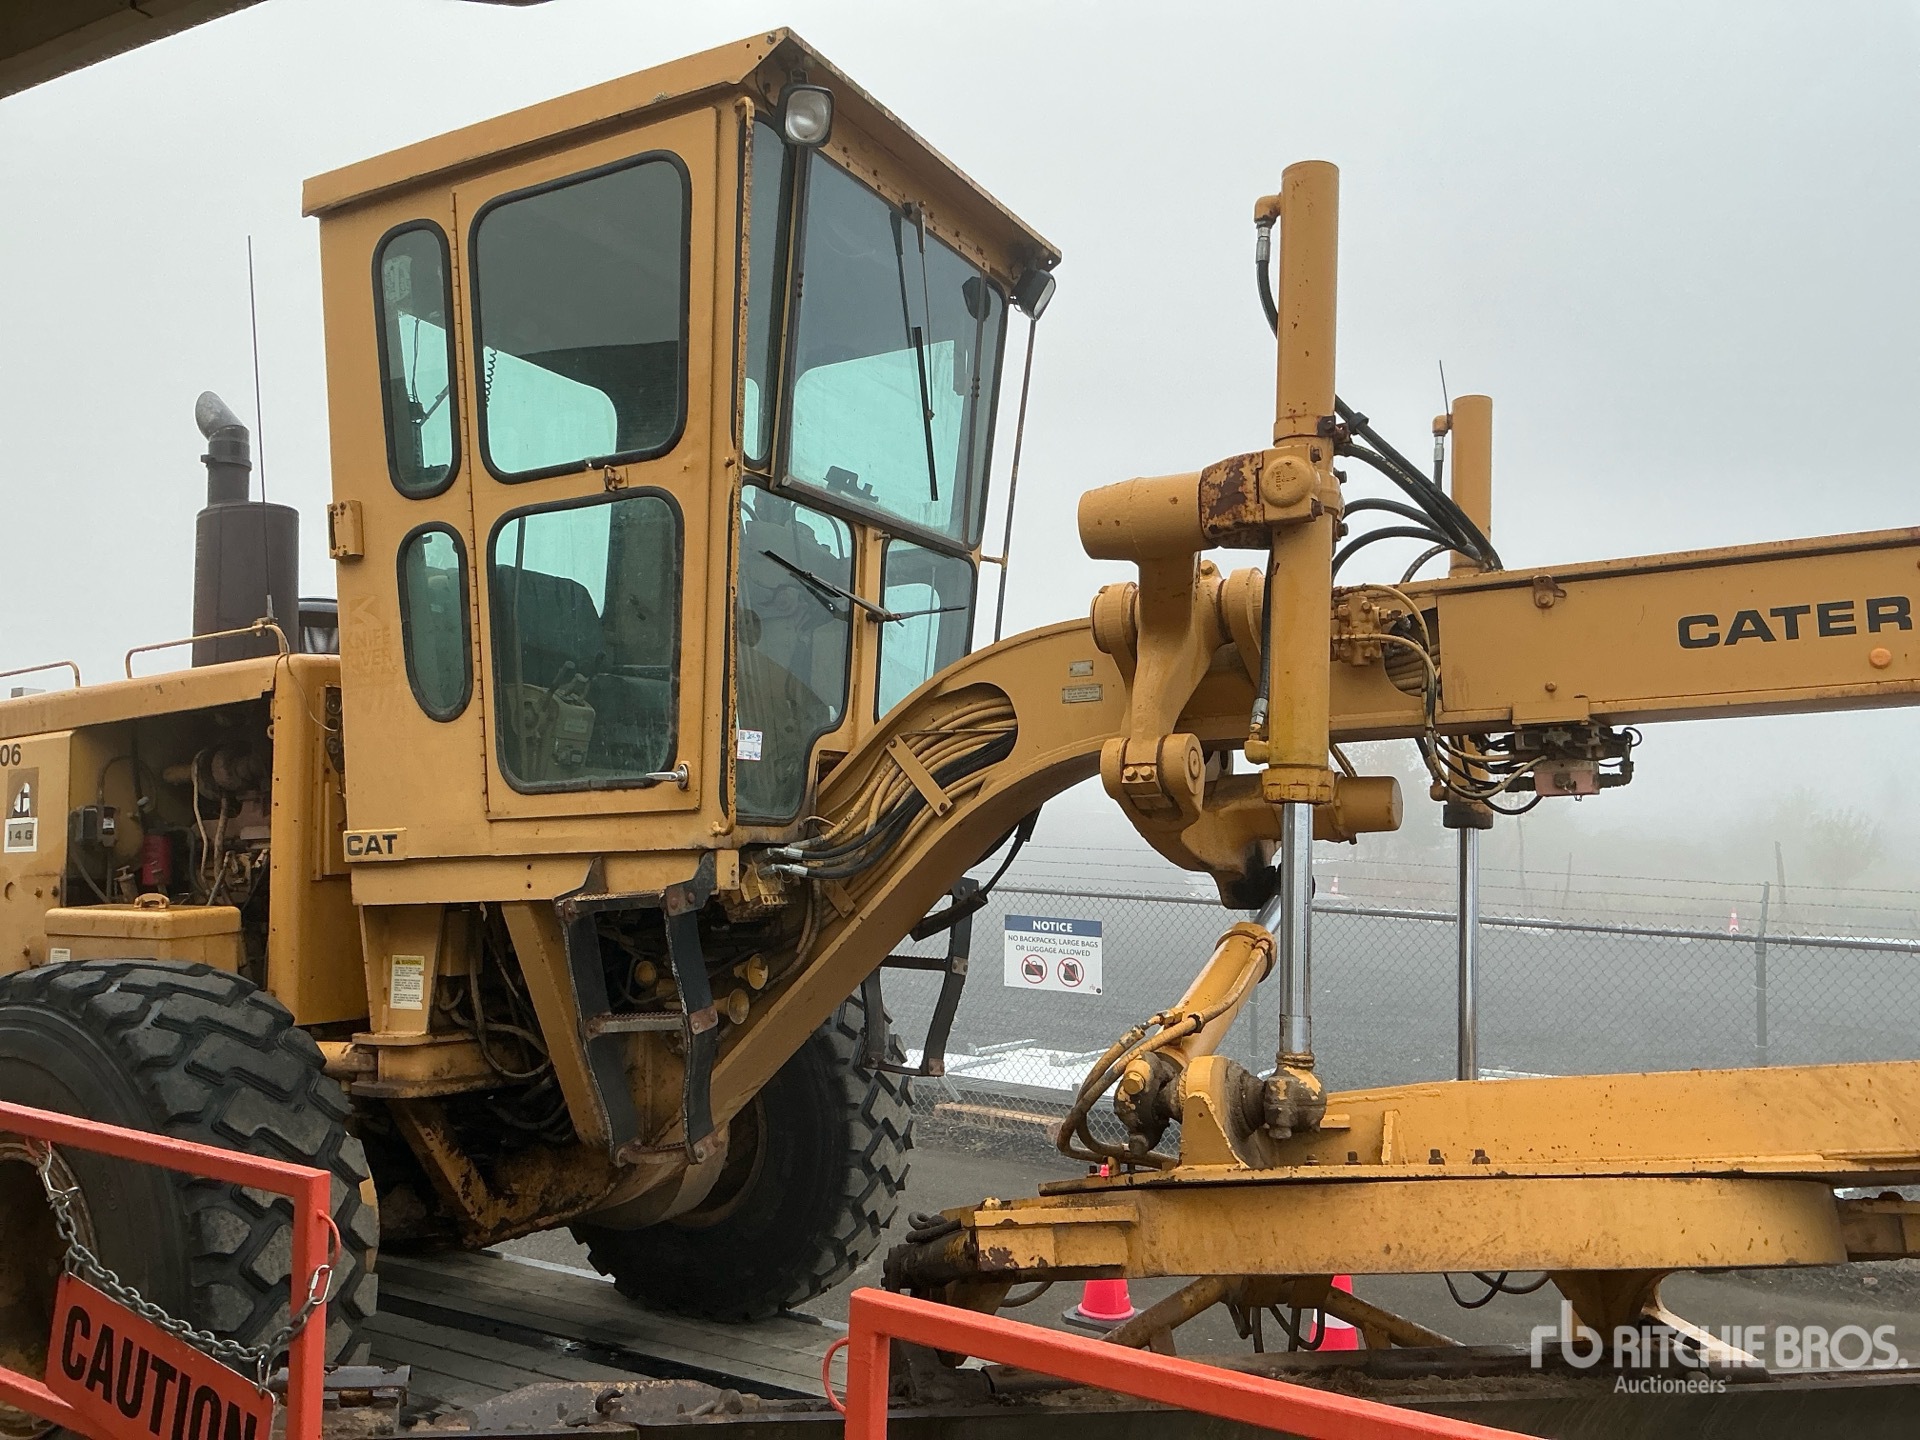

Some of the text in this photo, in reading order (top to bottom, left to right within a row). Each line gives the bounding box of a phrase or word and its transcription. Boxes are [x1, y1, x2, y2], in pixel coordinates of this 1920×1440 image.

[1677, 596, 1913, 650] CATER
[0, 743, 21, 767] 06
[347, 834, 398, 856] CAT
[1032, 920, 1073, 933] NOTICE
[1008, 934, 1099, 949] NO BACKPACKS, LARGE BAGS
[1015, 944, 1091, 957] OR LUGGAGE ALLOWED
